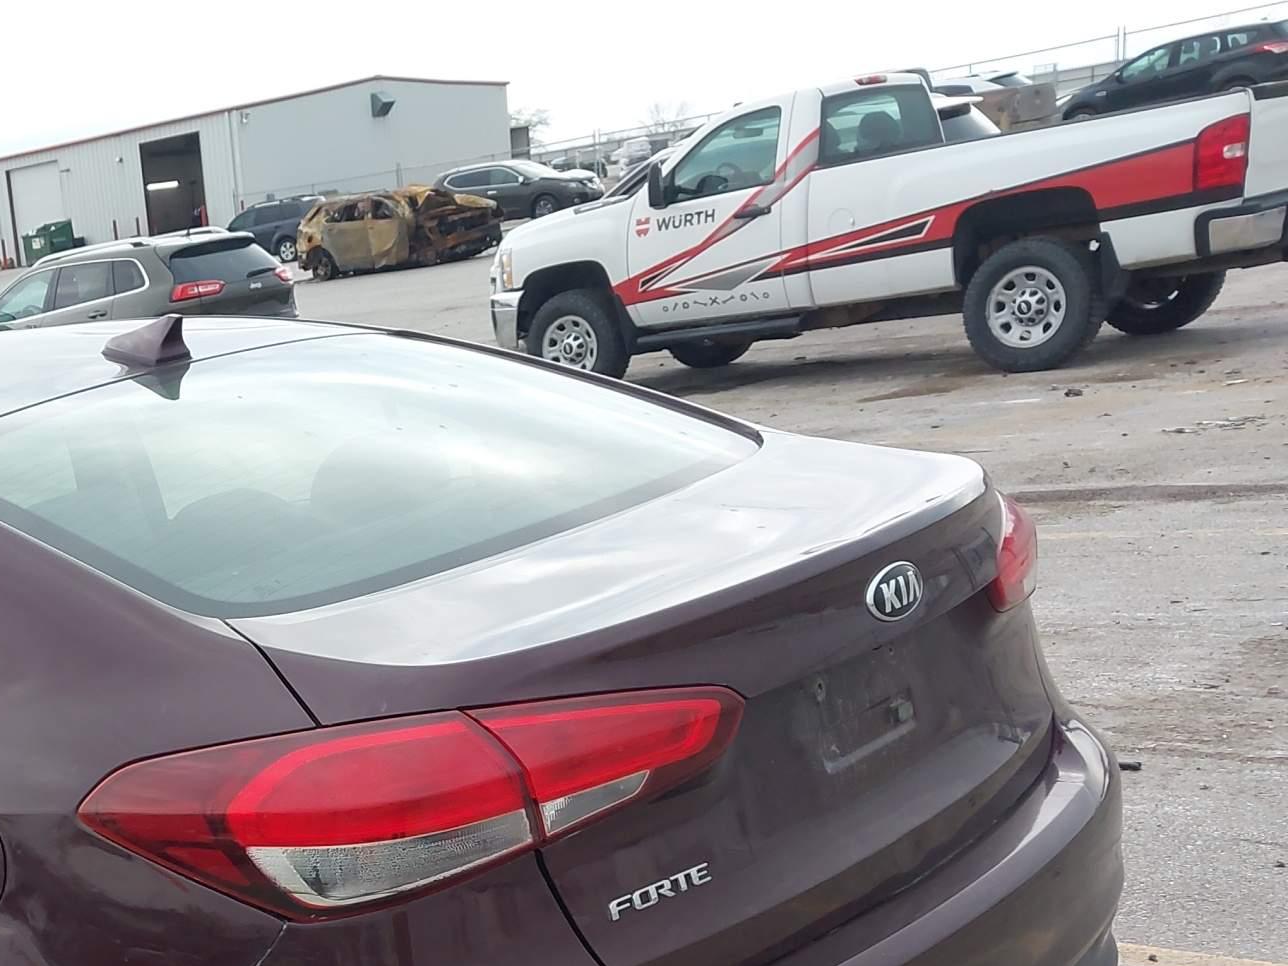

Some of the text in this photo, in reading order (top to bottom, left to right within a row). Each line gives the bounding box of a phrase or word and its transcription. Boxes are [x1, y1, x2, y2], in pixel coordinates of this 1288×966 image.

[656, 208, 716, 232] WÜRTH
[879, 570, 920, 613] KIA
[608, 862, 712, 921] FORTE
